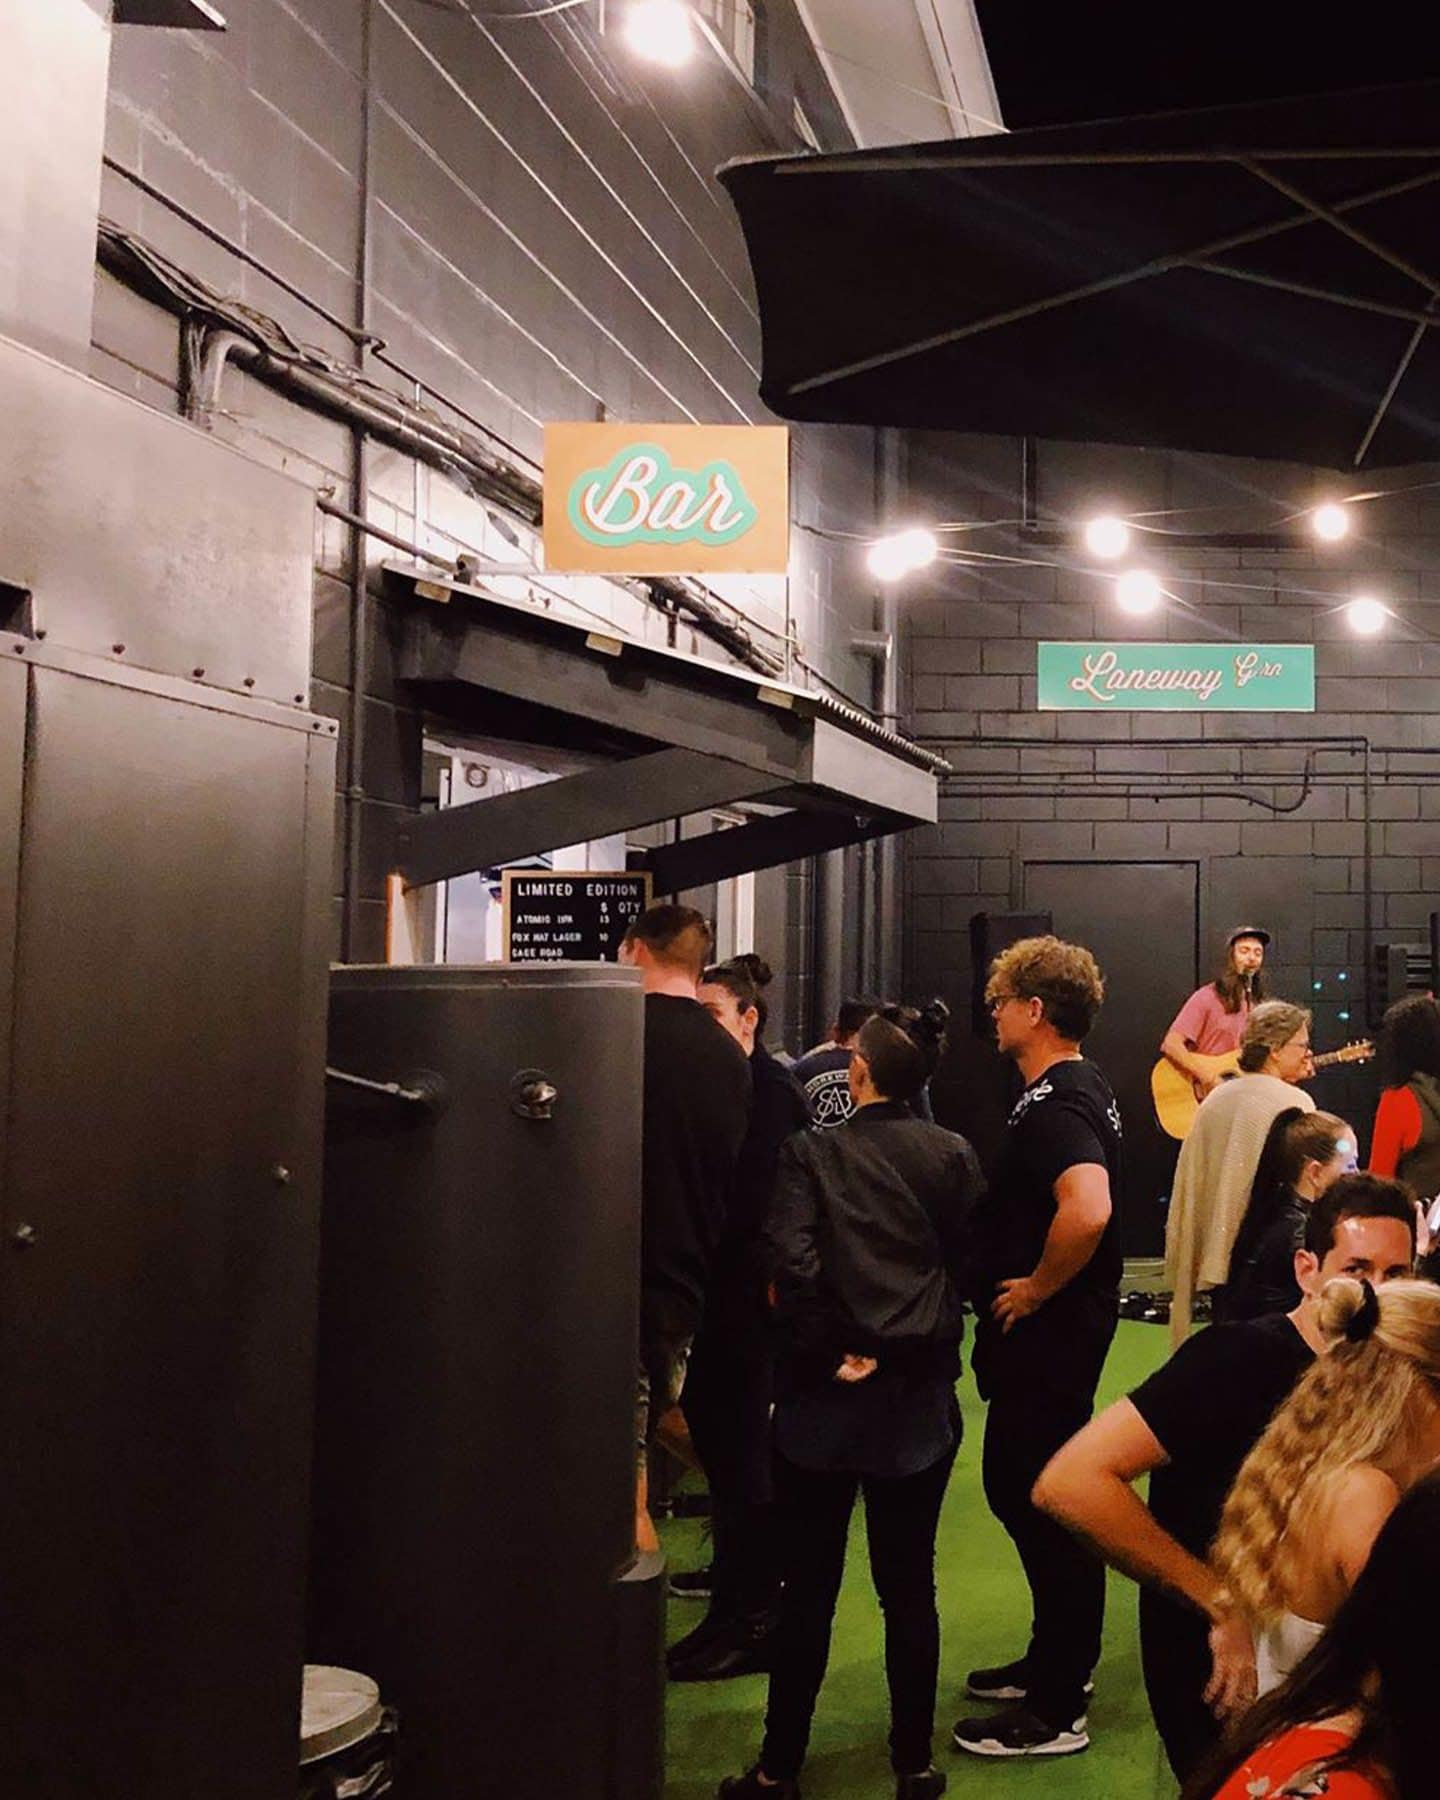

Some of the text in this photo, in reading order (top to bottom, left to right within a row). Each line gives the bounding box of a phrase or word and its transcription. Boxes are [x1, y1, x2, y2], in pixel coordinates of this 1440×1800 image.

[580, 455, 743, 534] Bar
[1070, 650, 1223, 701] Laneway
[517, 883, 638, 897] LIMITED EDITION
[618, 901, 641, 914] QTY
[512, 932, 530, 942] FOX
[533, 932, 549, 942] HAT
